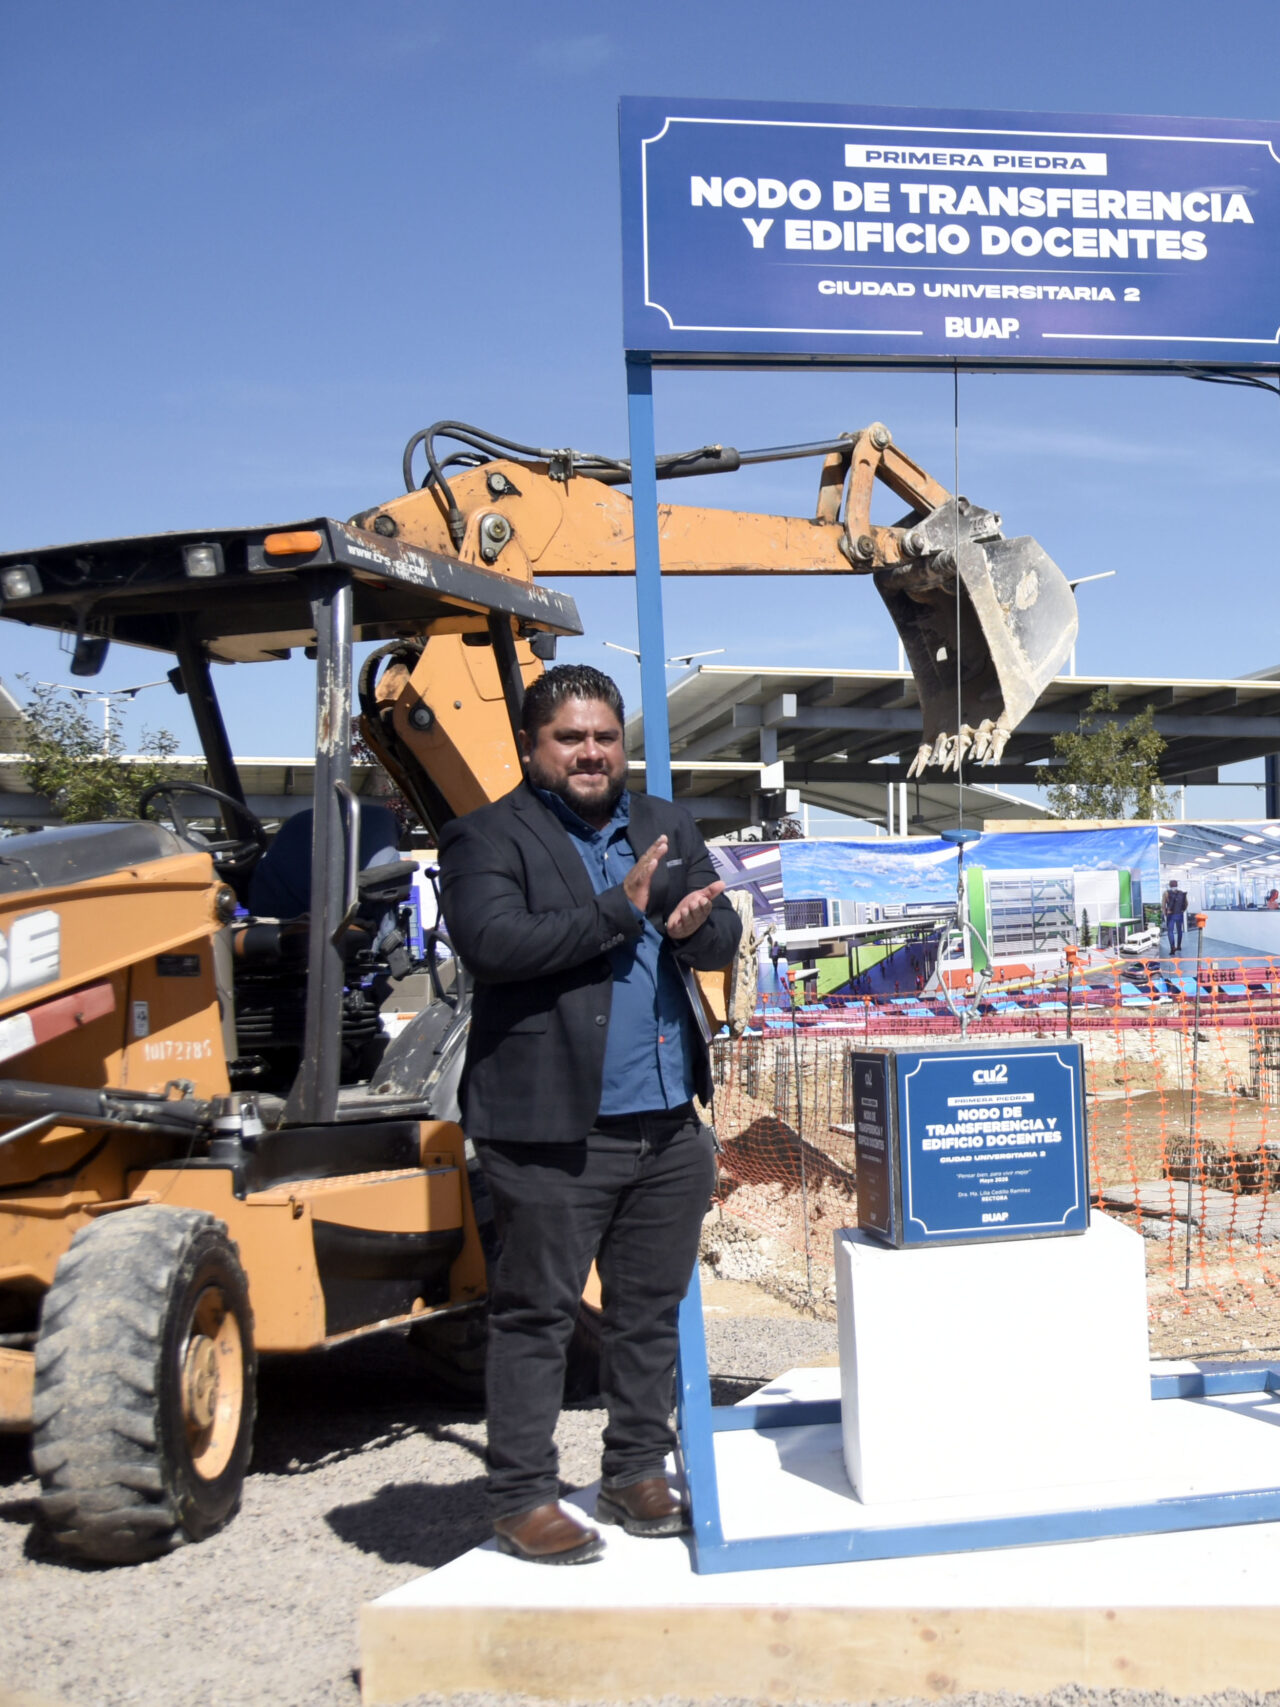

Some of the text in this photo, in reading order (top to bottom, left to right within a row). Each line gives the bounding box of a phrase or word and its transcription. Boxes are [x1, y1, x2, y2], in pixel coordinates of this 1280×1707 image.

[865, 150, 1087, 170] PRIMERA PIEDRA
[690, 175, 1255, 224] NODO DE TRANSFERENCIA
[742, 218, 1208, 261] Y EDIFICIO DOCENTES
[818, 280, 1141, 302] CIUDAD UNIVERSITARIA 2
[945, 316, 1020, 339] BUAP
[972, 1064, 1008, 1083] cu2
[954, 1094, 1028, 1104] PRIMERA PIEDRA
[957, 1106, 1022, 1121] NODO DE
[925, 1117, 1058, 1136] TRANSFERENCIA Y
[922, 1131, 1062, 1151] EDIFICIO DOCENTES
[940, 1155, 972, 1163] CIUDAD
[973, 1151, 1038, 1161] UNIVERSITARIA
[981, 1212, 1009, 1223] BUAP
